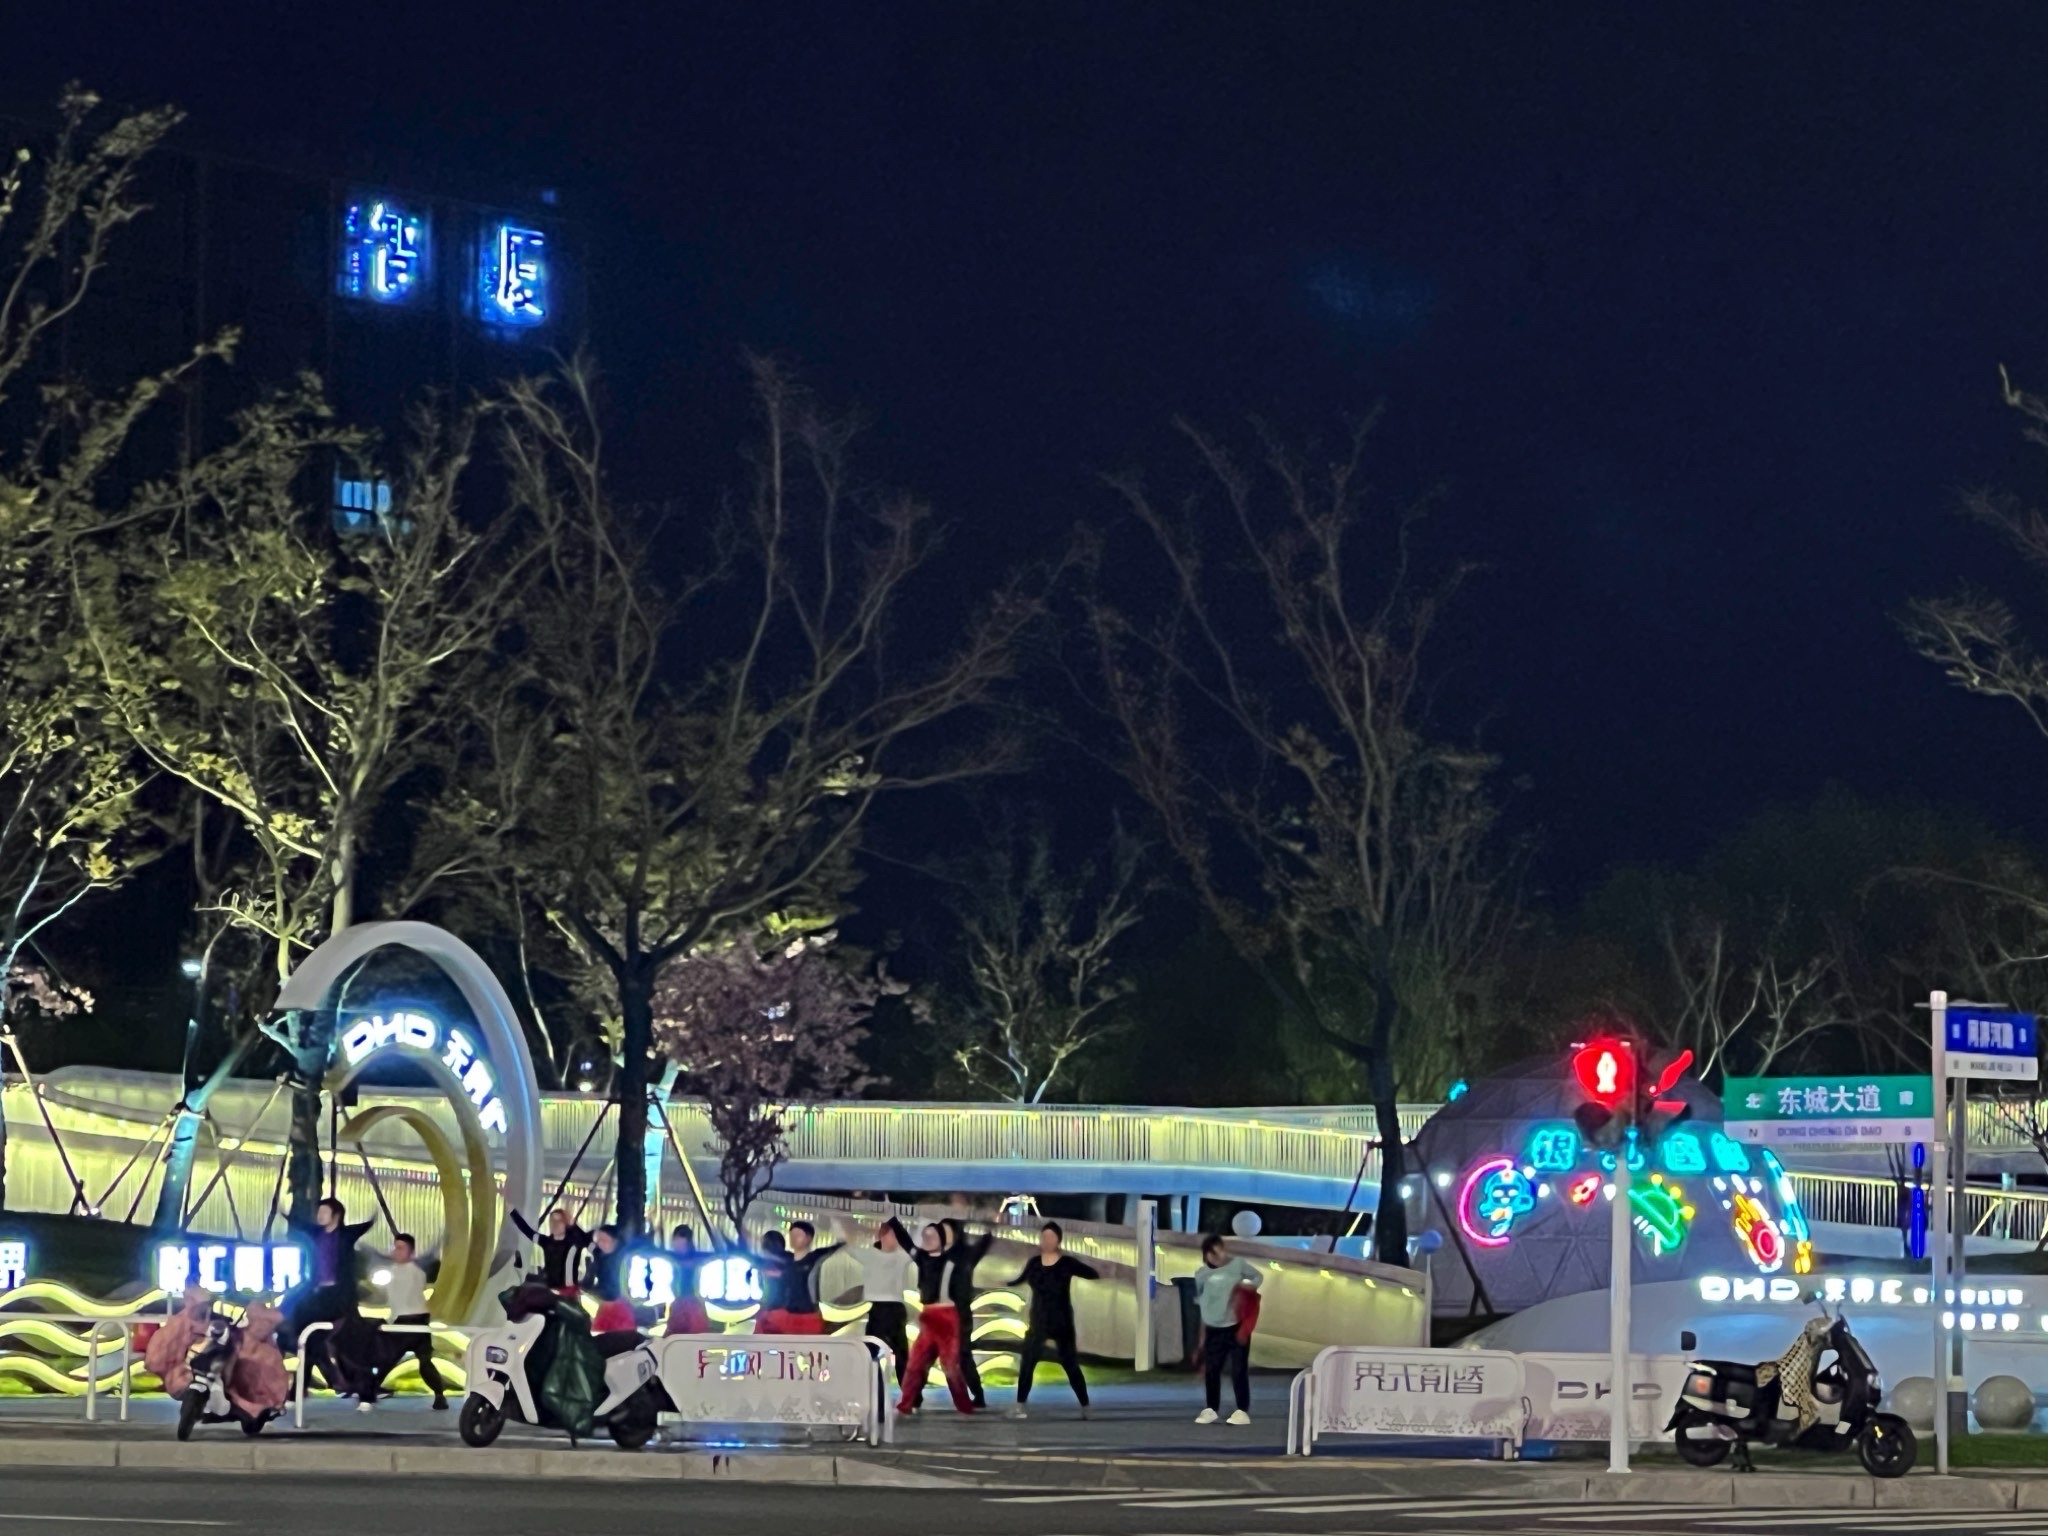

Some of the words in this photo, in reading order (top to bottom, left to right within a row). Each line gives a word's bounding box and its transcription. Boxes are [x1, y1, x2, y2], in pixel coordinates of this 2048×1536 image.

[1745, 1092, 1761, 1109] 北
[1777, 1085, 1882, 1115] 东城大道
[1748, 1128, 1758, 1138] N
[1777, 1126, 1806, 1137] DONG
[1808, 1126, 1843, 1137] CHENG
[1844, 1126, 1859, 1136] DA
[1860, 1125, 1882, 1136] DAO
